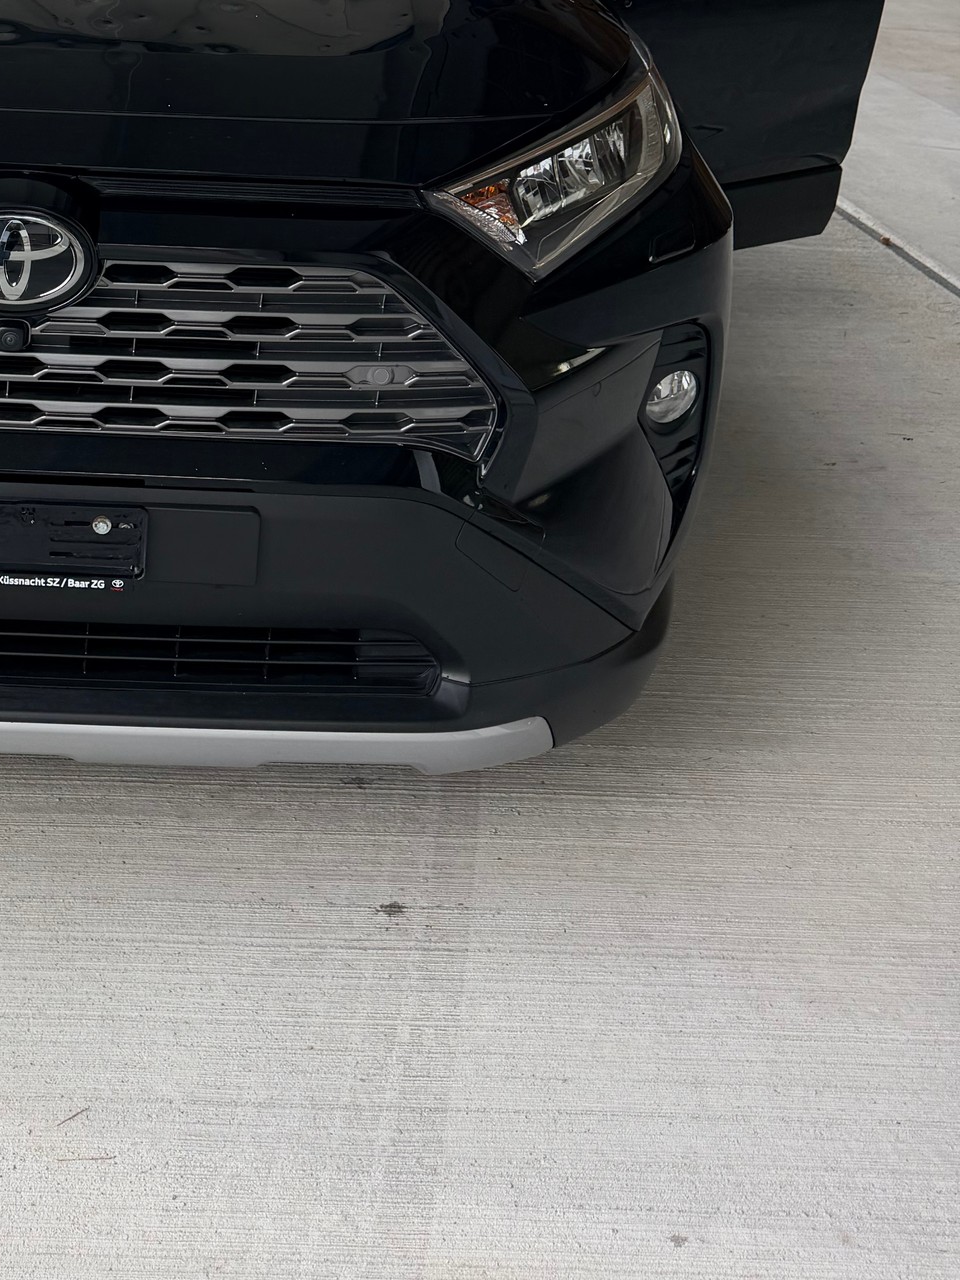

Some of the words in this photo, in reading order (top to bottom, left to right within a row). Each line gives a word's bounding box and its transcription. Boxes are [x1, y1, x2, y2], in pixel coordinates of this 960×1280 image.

[46, 577, 60, 587] SZ
[67, 579, 90, 588] Baar
[91, 580, 105, 589] ZG
